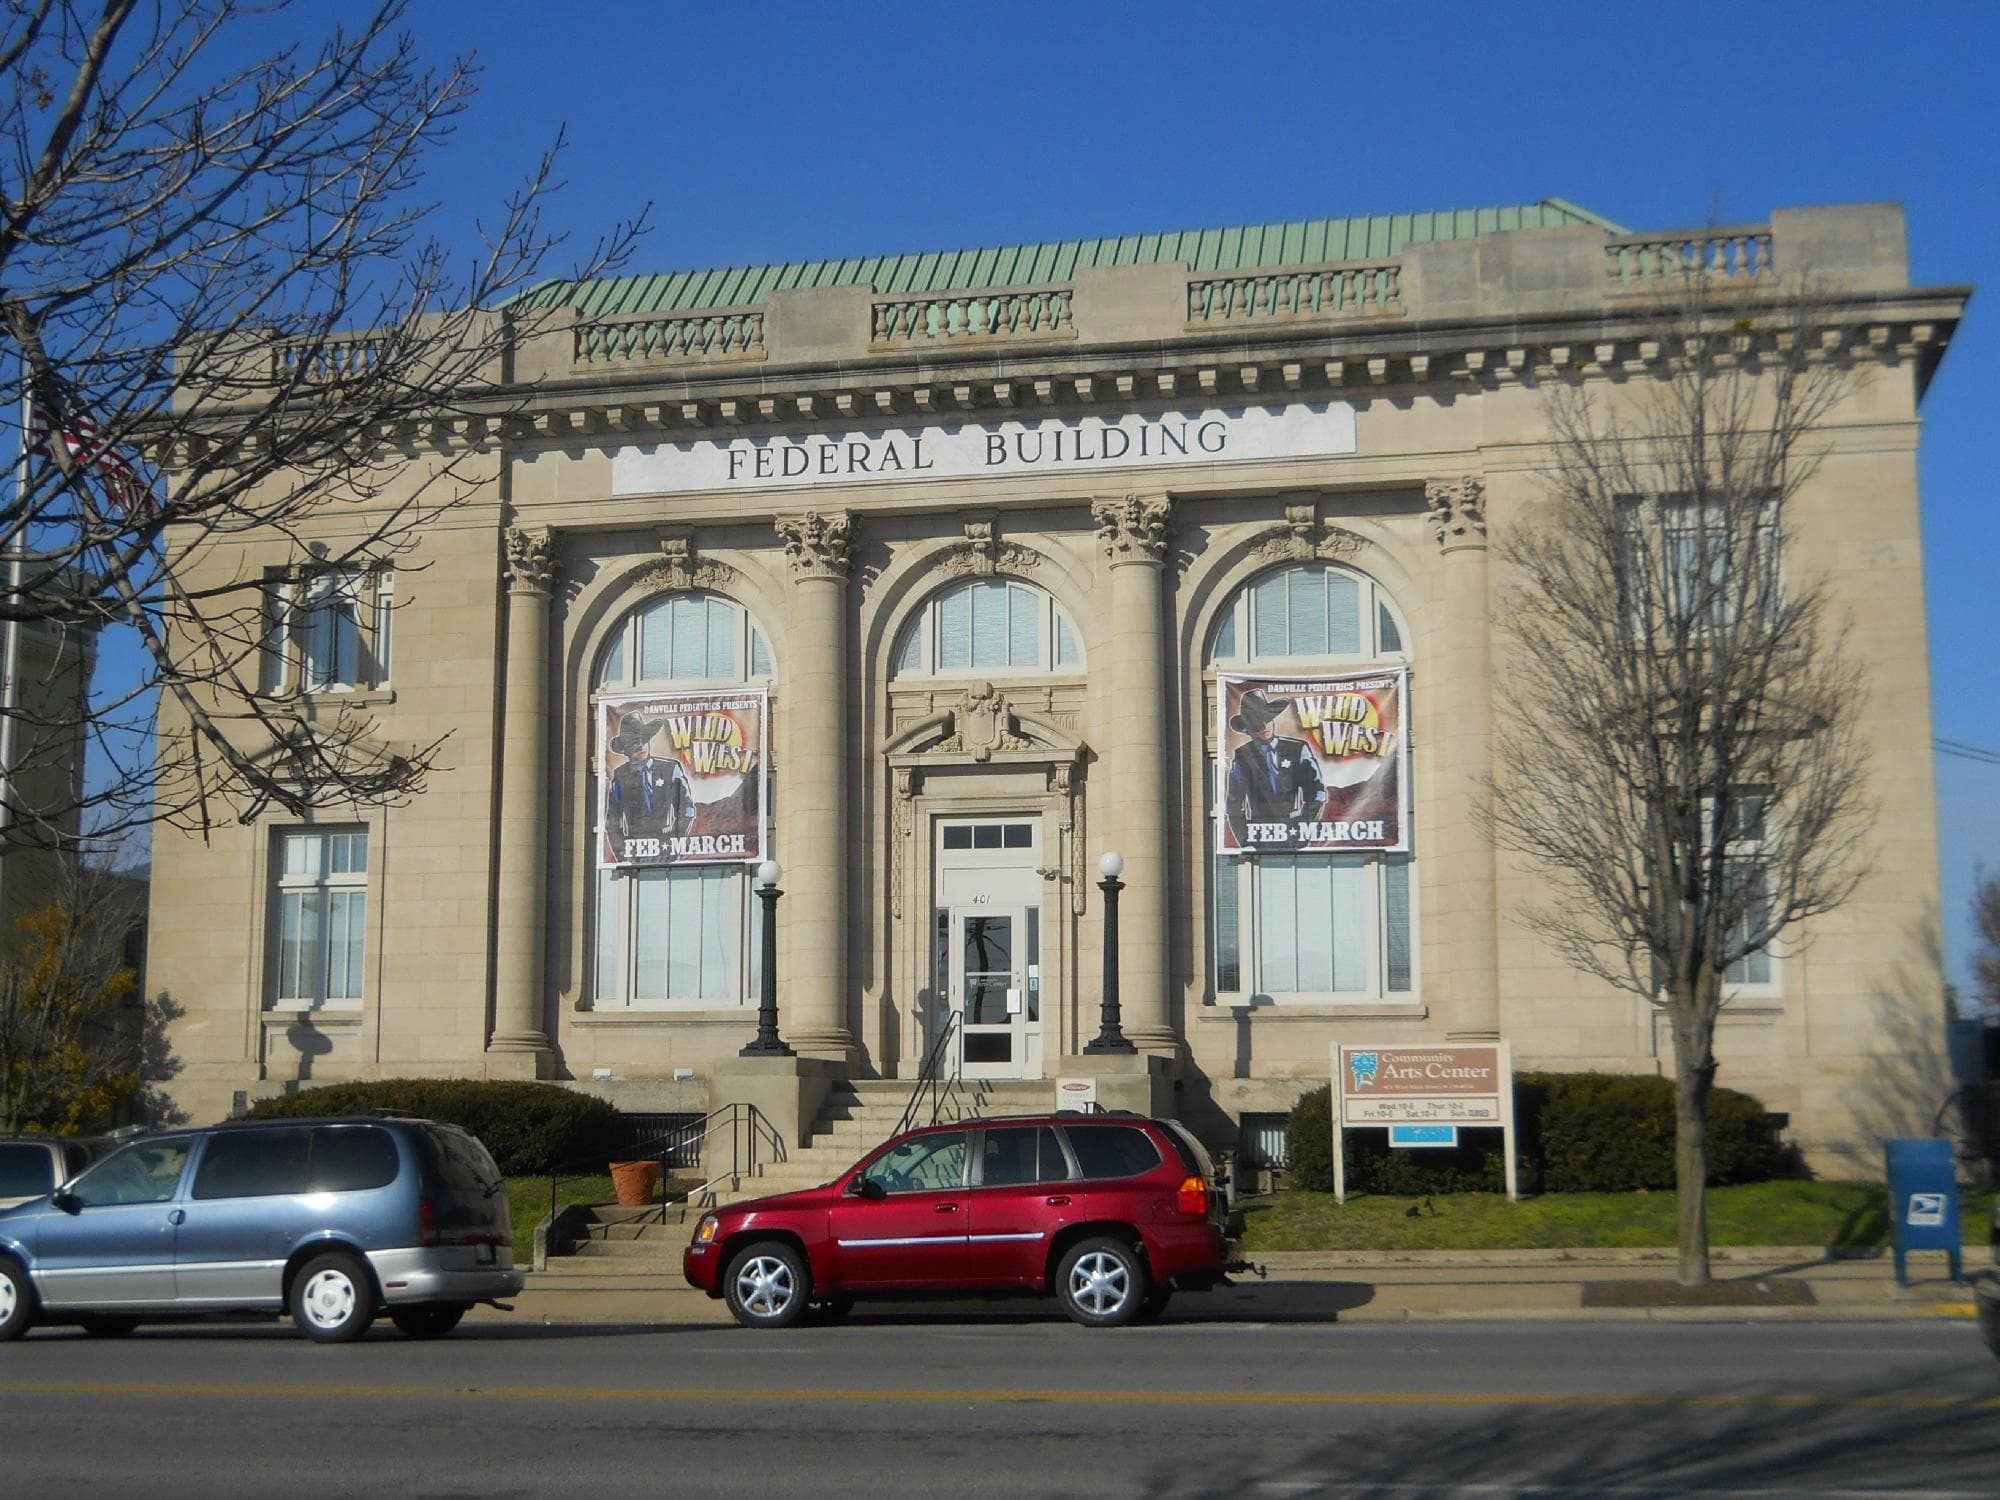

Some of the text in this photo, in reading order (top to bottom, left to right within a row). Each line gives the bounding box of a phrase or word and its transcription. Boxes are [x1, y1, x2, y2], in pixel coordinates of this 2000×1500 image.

[726, 420, 1228, 480] FEDERAL BUILDING
[1267, 683, 1306, 693] DANVILLE
[644, 700, 757, 714] DANVILLE PEDIATRICS PRESENTS
[1294, 695, 1367, 728] WILD
[667, 715, 733, 749] WILD
[1321, 721, 1394, 757] WEST
[692, 741, 756, 774] WEST
[1246, 820, 1384, 842] FEB MARCH
[623, 834, 746, 858] FEB MARCH
[972, 894, 991, 904] 401
[1381, 1052, 1456, 1065] Community
[1384, 1063, 1490, 1079] Arts Center
